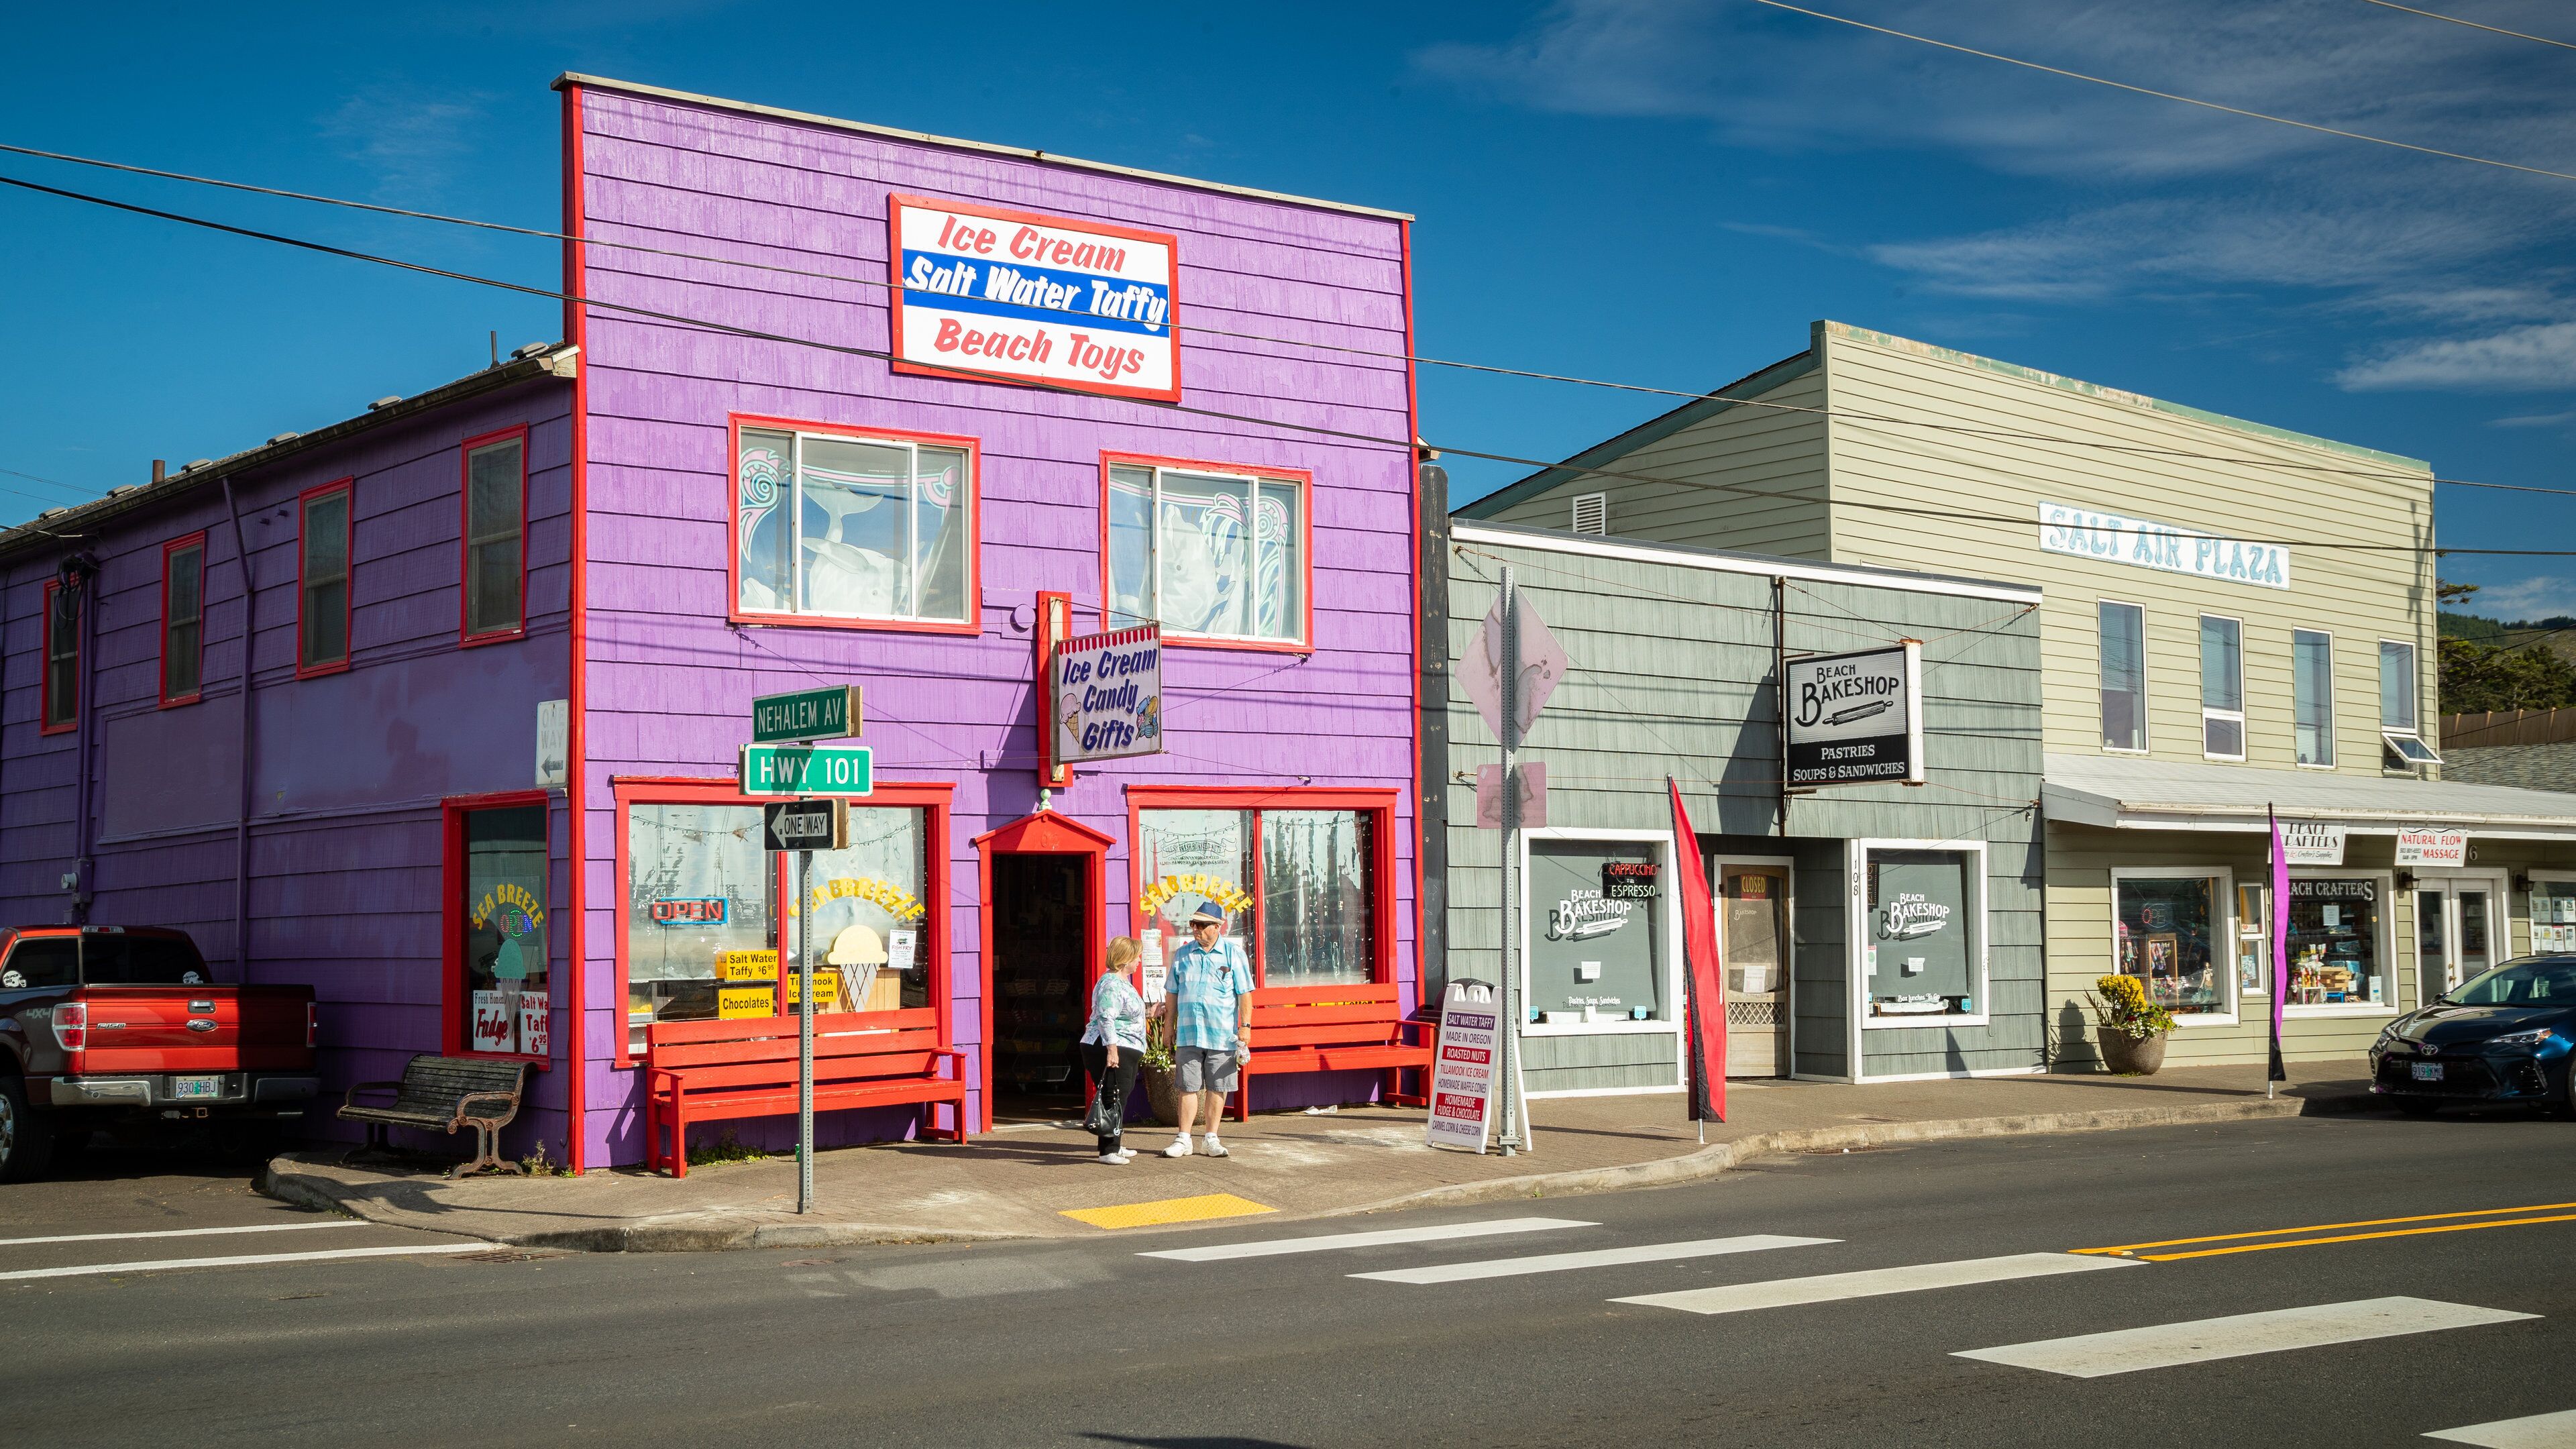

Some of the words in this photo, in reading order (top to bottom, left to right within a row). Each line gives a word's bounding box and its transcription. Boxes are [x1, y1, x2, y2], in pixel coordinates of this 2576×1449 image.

[938, 215, 996, 254] Ice
[1010, 226, 1126, 272] Cream
[905, 256, 977, 296] Salt
[985, 266, 1081, 311] Water
[1090, 280, 1167, 331] Taffy
[934, 318, 1053, 364] Beach
[1068, 333, 1144, 380] Toys
[2050, 509, 2122, 556] SALT
[2133, 524, 2182, 568] AIR
[2196, 537, 2282, 584] PLAZA
[1063, 657, 1091, 684] Ice
[1097, 648, 1157, 679] Cream
[1817, 664, 1856, 684] BEACH
[1083, 679, 1138, 714] Candy
[1794, 676, 1899, 727] BAKESHOP
[758, 700, 817, 733] NEHALEM
[824, 698, 841, 726] AV
[1083, 720, 1134, 751] Gifts
[1821, 744, 1875, 760] PASTRIES
[761, 757, 812, 784] HWY
[826, 757, 858, 784] 101
[1793, 769, 1827, 781] SOUPS
[1829, 767, 1836, 778] &
[1838, 761, 1904, 778] SANDWICHES
[784, 815, 802, 835] ONE
[806, 815, 825, 835] WAY
[2401, 835, 2436, 845] NATURAL
[2441, 836, 2462, 845] FLOW
[2423, 849, 2459, 859] MASSAGE
[2469, 845, 2477, 861] 6
[1610, 864, 1657, 875] CAPPUCCINO
[1611, 885, 1655, 897] ESPRESSO
[1742, 876, 1765, 893] CLOSED
[2288, 882, 2312, 896] ACH
[2316, 881, 2373, 901] CRAFTERS
[839, 877, 925, 921] BREEZE
[1140, 881, 1177, 917] SEA
[1180, 873, 1253, 913] BREEZE
[1571, 890, 1601, 902] BEACH
[1900, 893, 1925, 904] BEACH
[473, 893, 495, 930] SEA
[497, 883, 544, 928] BREEZE
[653, 902, 722, 920] OPEN
[500, 914, 532, 933] OPEN
[1554, 900, 1631, 934] BAKESHOP
[1886, 902, 1949, 932] BAKESHOP
[730, 955, 747, 964] Salt
[751, 953, 777, 963] Water
[730, 967, 753, 977] Taffy
[790, 977, 833, 985] Timook
[475, 993, 488, 1004] Fresh
[490, 993, 506, 1004] Homem
[521, 996, 536, 1010] Salt
[538, 997, 547, 1010] Wa
[723, 997, 769, 1010] Chocolates
[1909, 994, 1925, 1003] Lunches
[476, 1008, 508, 1046] Fudge
[1448, 1014, 1460, 1024] SALT
[1460, 1016, 1478, 1026] WATER
[1479, 1017, 1494, 1028] TAFFY
[1446, 1031, 1462, 1042] MADE
[1462, 1032, 1468, 1042] IN
[1469, 1033, 1491, 1044] OREGON
[1446, 1048, 1470, 1059] ROASTED
[1471, 1049, 1486, 1061] NUTS
[1440, 1064, 1465, 1076] TILLAMOOK
[1473, 1067, 1489, 1079] CREAM
[178, 1082, 194, 1093] 930
[201, 1081, 216, 1092] HBJ
[1438, 1078, 1460, 1089] HOMEMADE
[1460, 1081, 1474, 1091] WAFFLE
[1474, 1083, 1487, 1093] CONES
[1445, 1094, 1476, 1108] HOMEMADE
[1437, 1105, 1452, 1116] FUDGE
[1452, 1107, 1455, 1116] &
[1456, 1108, 1480, 1120] CHOCOLATE
[1432, 1120, 1446, 1131] CARMEL
[1446, 1122, 1455, 1132] CORN
[1456, 1124, 1458, 1133] &
[1458, 1124, 1471, 1135] CHEESE
[1471, 1126, 1481, 1136] CORN
